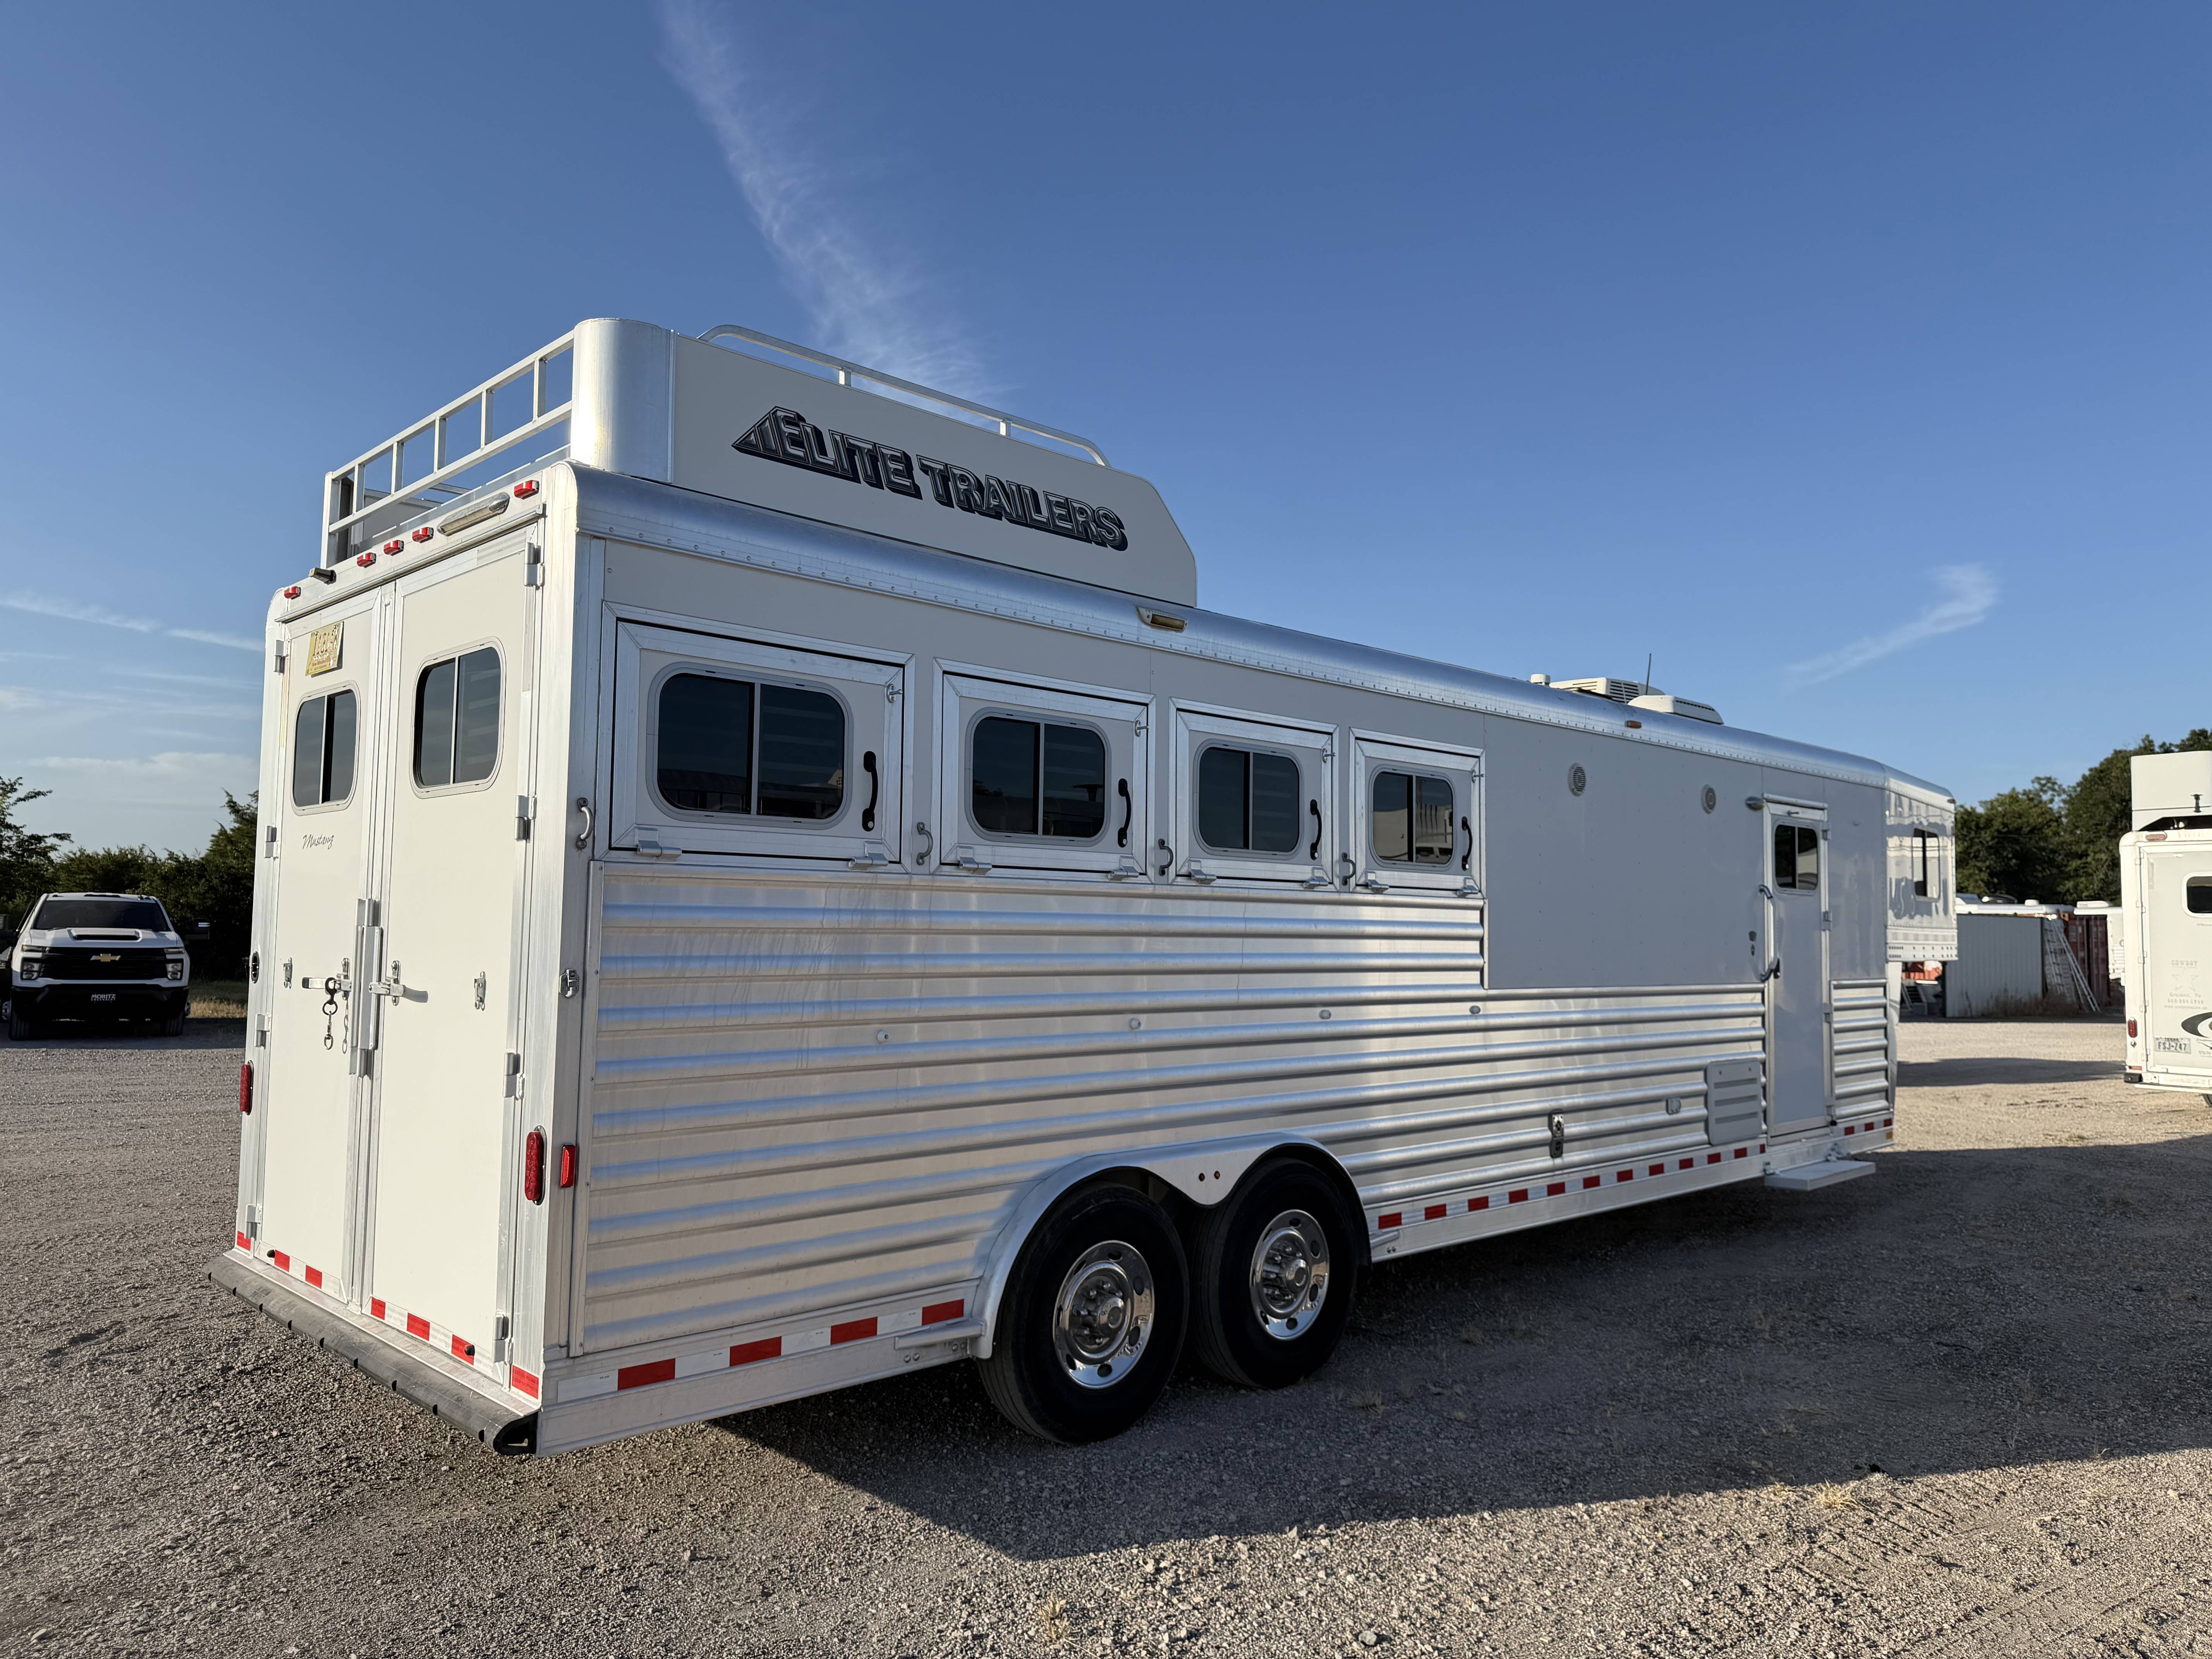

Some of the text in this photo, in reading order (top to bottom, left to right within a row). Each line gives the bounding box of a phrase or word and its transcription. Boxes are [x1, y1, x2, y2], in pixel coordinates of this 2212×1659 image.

[771, 405, 1129, 552] ELITE TRAILERS
[302, 834, 334, 850] Mustang
